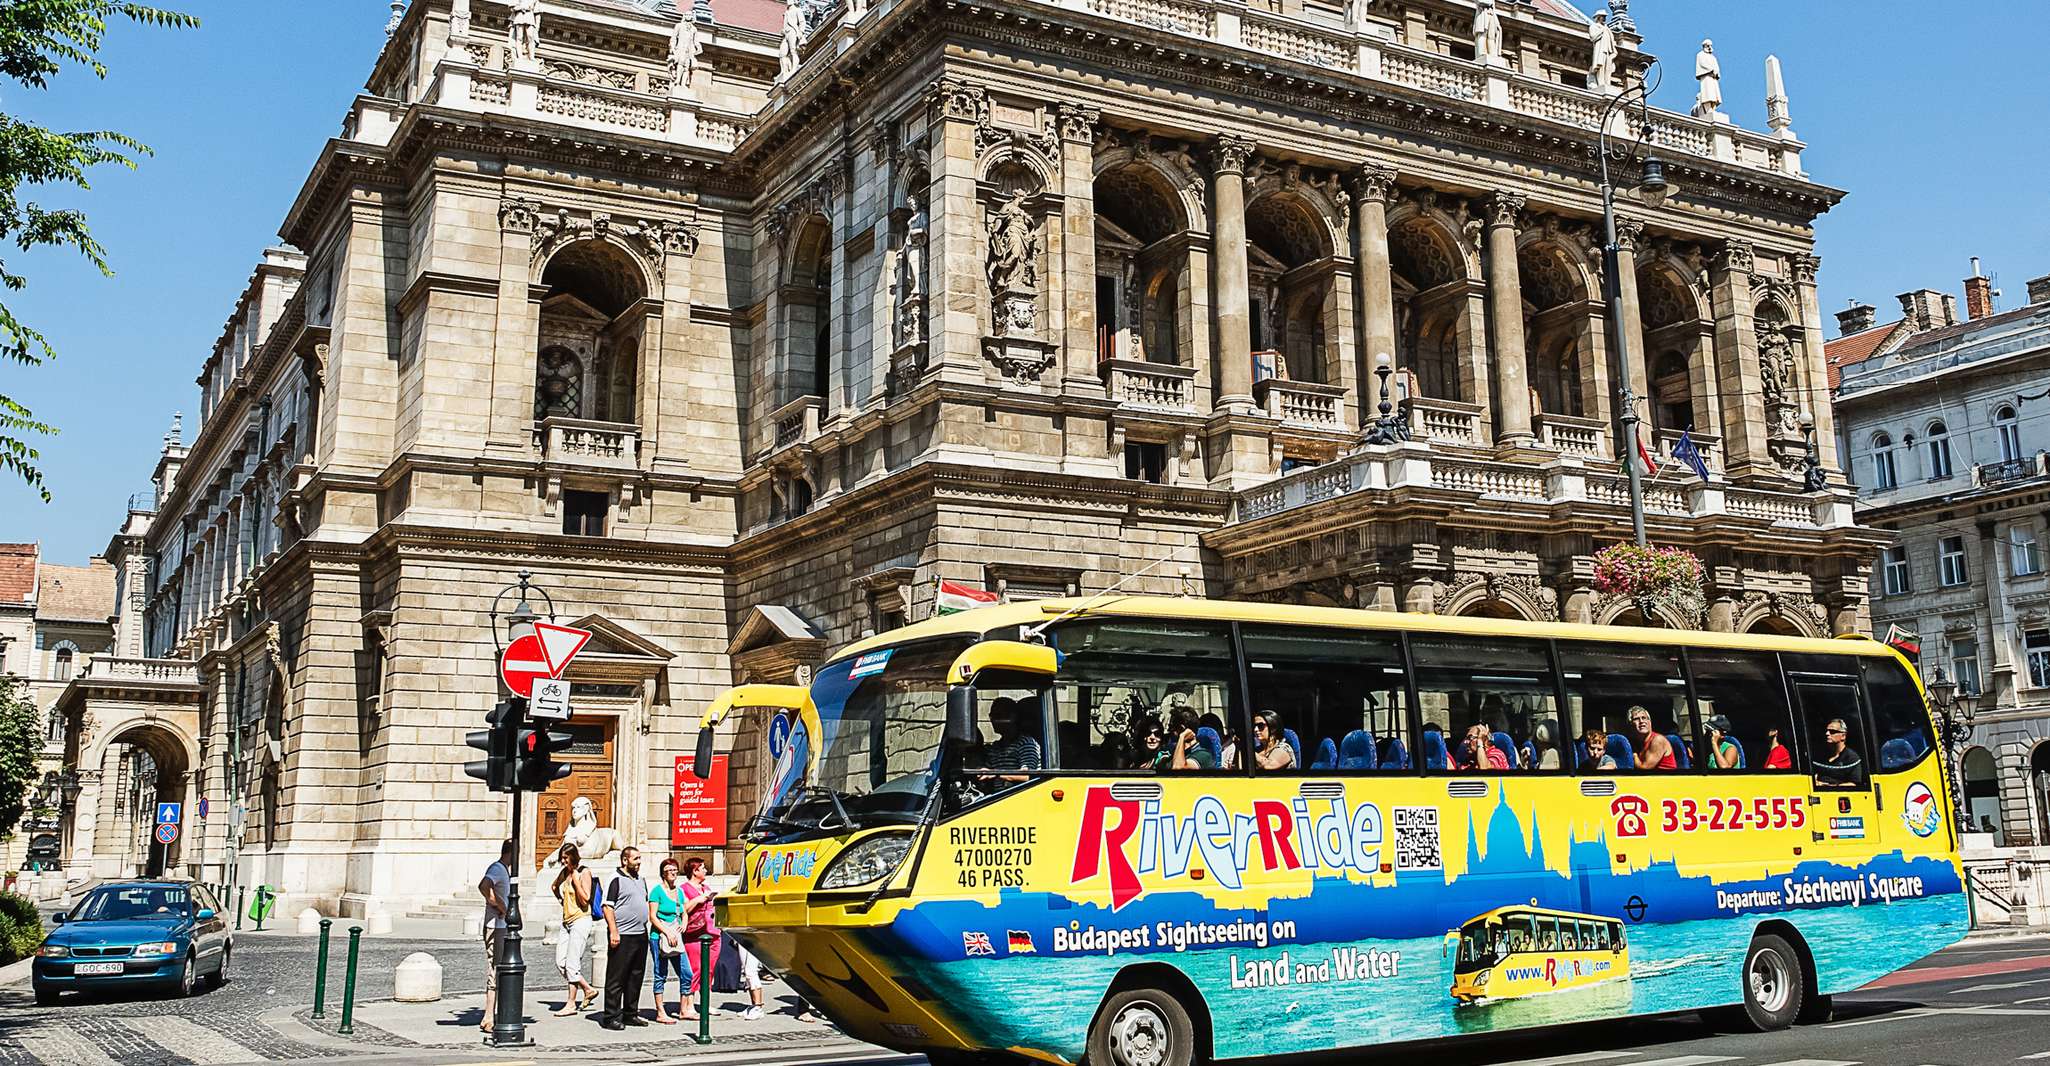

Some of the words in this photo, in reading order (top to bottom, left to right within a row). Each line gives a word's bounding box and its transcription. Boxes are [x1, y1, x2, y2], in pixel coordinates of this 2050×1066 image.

[677, 763, 694, 772] OPE
[680, 781, 698, 790] Opera
[680, 790, 694, 798] open
[694, 789, 704, 798] for
[680, 797, 699, 806] guided
[1662, 797, 1806, 832] 33-22-555
[950, 826, 1037, 845] RIVERRIDE
[954, 848, 1032, 867] 47000270
[1071, 786, 1383, 912] RiverRide
[752, 848, 816, 888] RiverRide
[958, 869, 977, 888] 46
[982, 868, 1030, 887] PASS.
[1717, 889, 1782, 913] Departure:
[1783, 873, 1867, 908] Széchenyi
[1868, 873, 1923, 905] Square
[1053, 924, 1151, 956] Budapest
[1156, 920, 1269, 952] Sightseeing
[1271, 920, 1296, 939] on
[1230, 952, 1290, 990] Land
[1294, 959, 1330, 984] and
[1332, 947, 1401, 981] Water
